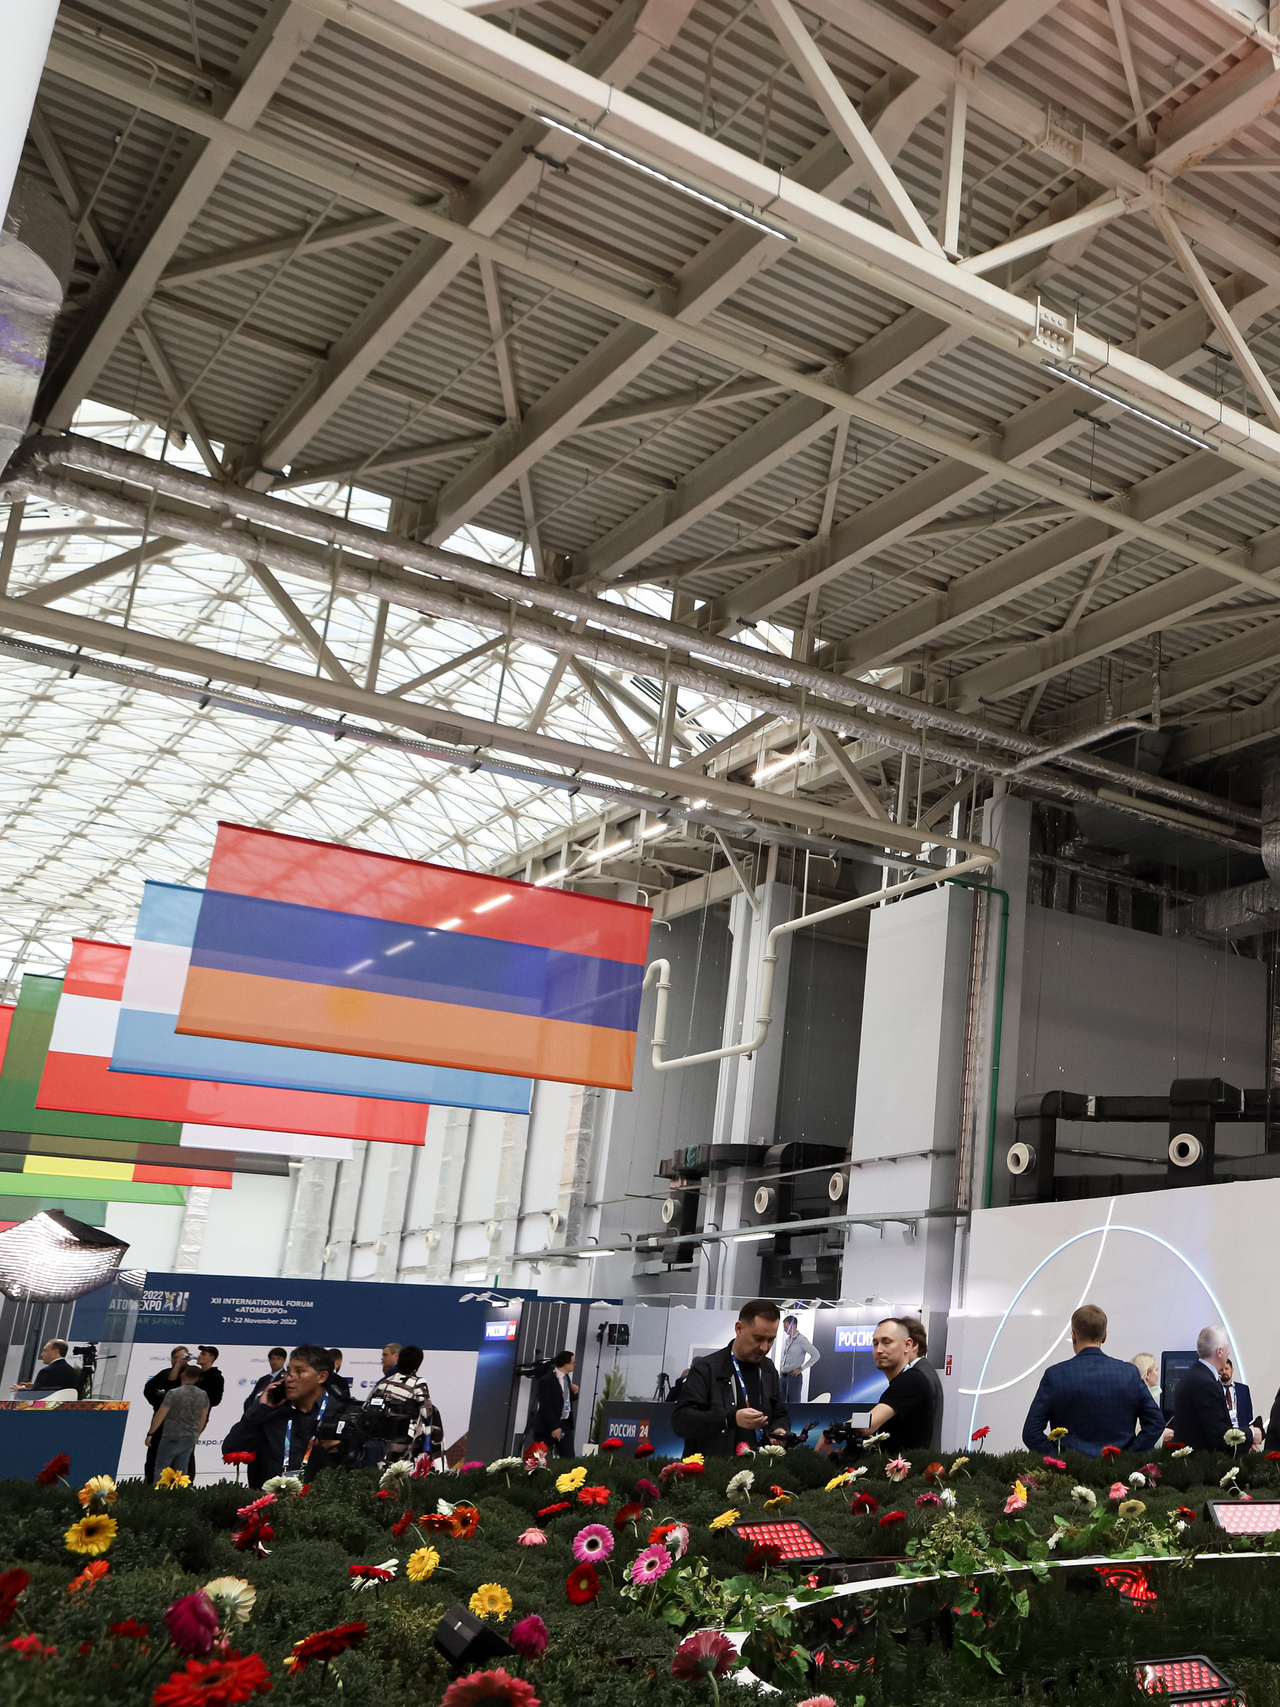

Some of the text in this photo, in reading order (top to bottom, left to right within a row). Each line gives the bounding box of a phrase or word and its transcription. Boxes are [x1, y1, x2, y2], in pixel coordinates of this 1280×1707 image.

[142, 1290, 164, 1300] 2022
[222, 1298, 284, 1307] INTERNATIONAL
[285, 1300, 314, 1308] FORUM
[152, 1317, 185, 1326] SPRING
[221, 1316, 298, 1326] 21-22 November 2022
[508, 1325, 516, 1336] 24
[609, 1423, 649, 1438] РОССИЯ 24
